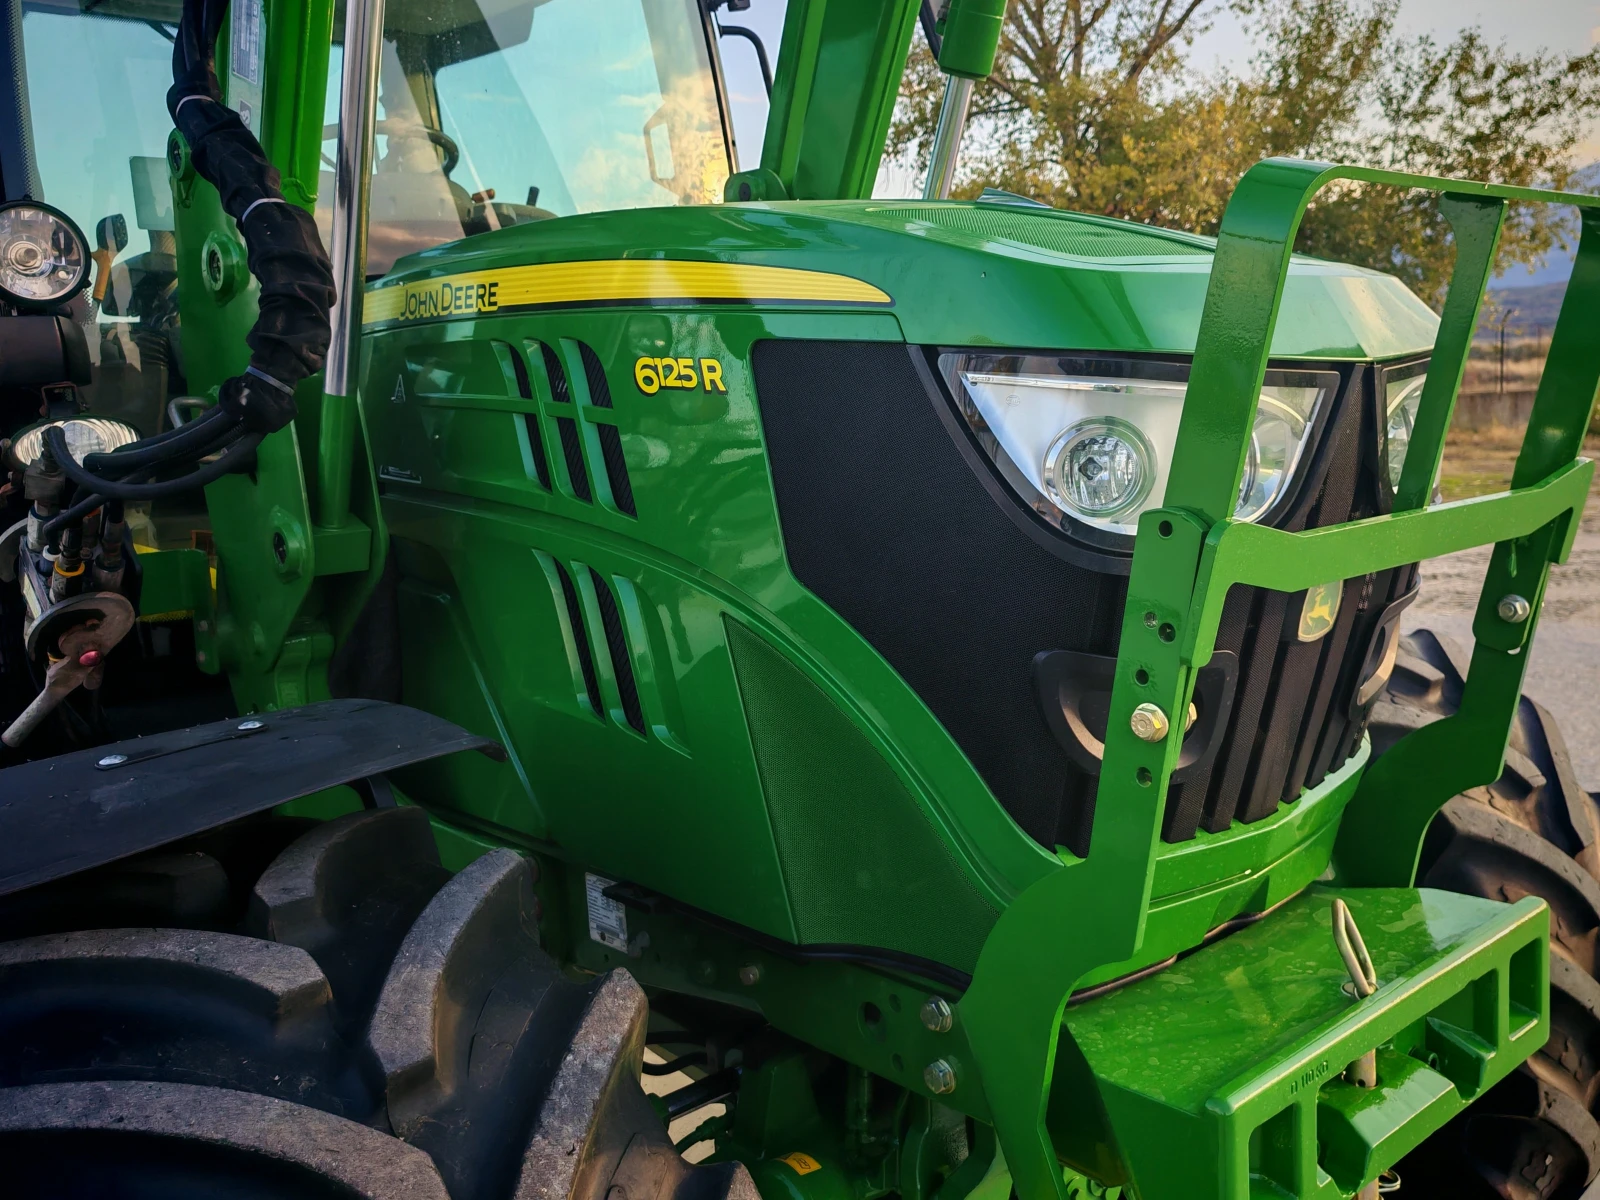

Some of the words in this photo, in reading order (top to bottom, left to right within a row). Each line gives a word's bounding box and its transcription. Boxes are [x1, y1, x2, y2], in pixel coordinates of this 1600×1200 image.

[400, 289, 438, 318] JOHN
[441, 281, 499, 312] DEERE
[634, 356, 698, 396] 6125
[699, 358, 728, 395] R
